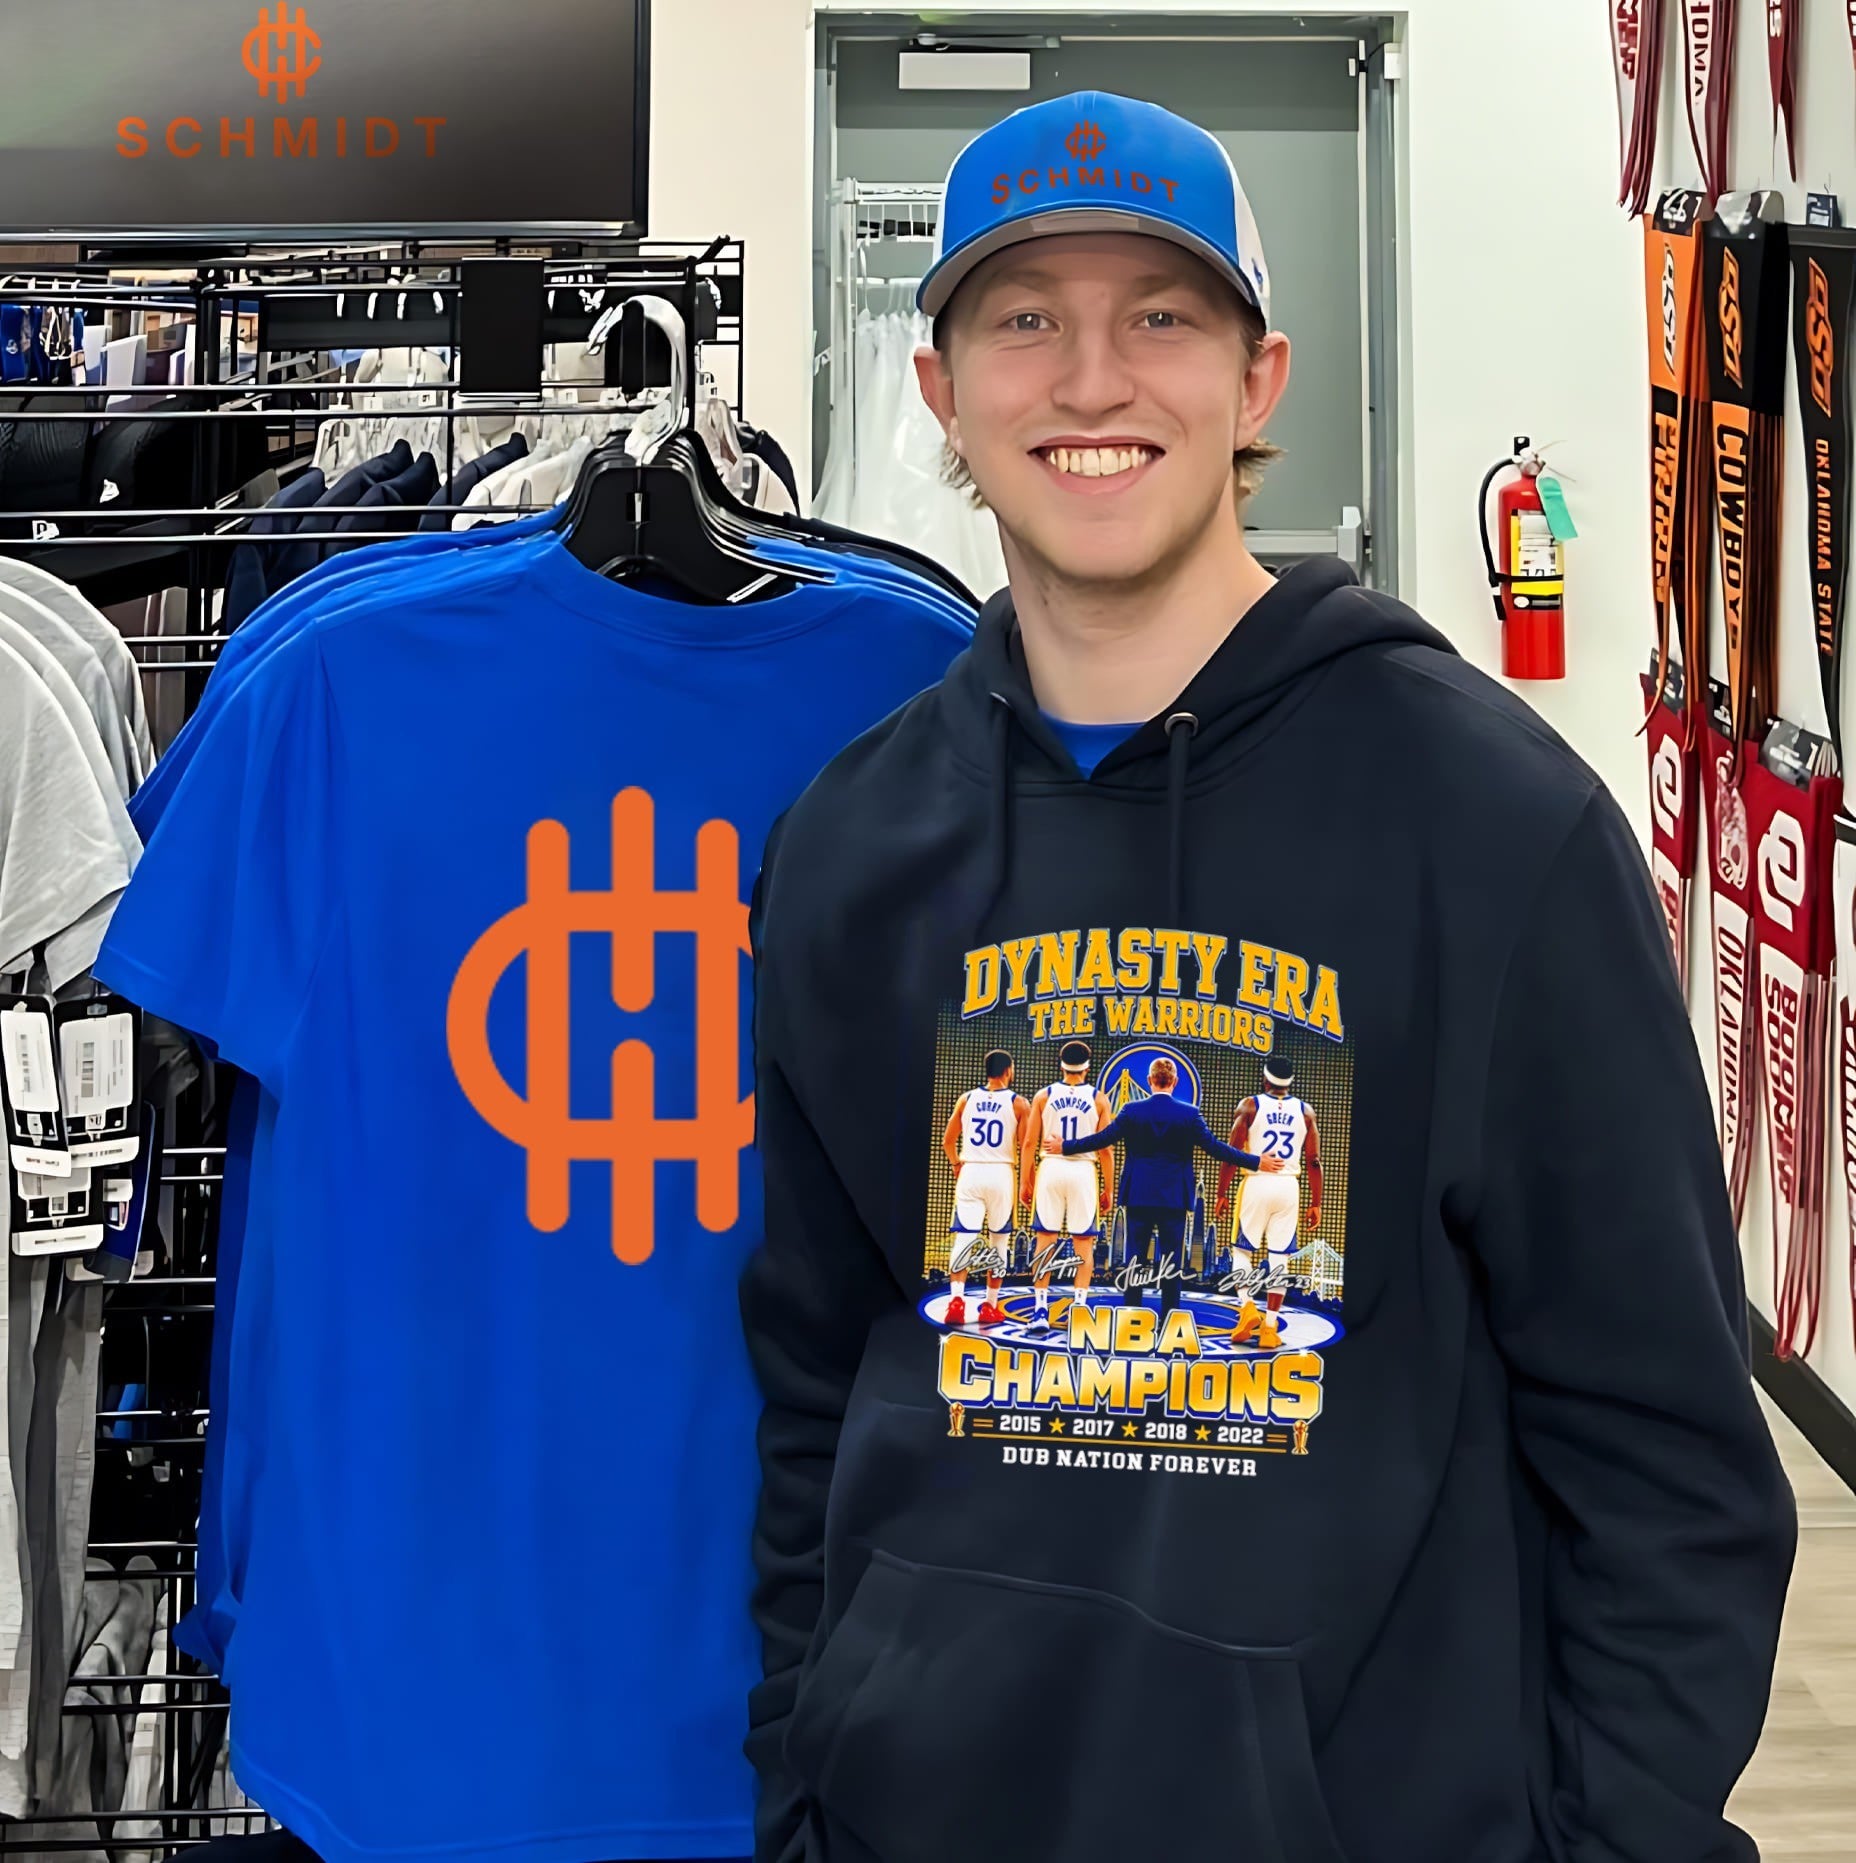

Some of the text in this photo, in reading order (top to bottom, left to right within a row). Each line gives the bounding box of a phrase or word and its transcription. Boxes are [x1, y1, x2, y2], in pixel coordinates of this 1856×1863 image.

[115, 116, 448, 158] SCHMIDT
[991, 167, 1179, 205] SCHMIDT
[1815, 438, 1832, 570] OKLAHOMA
[961, 927, 1344, 1043] DYNASTY ERA
[1028, 996, 1274, 1056] THE WARRIORS
[1050, 1097, 1093, 1115] THOMPSON
[970, 1117, 1004, 1148] 30
[1060, 1115, 1077, 1142] 11
[1262, 1130, 1295, 1159] 23
[1068, 1305, 1203, 1358] NBA
[938, 1333, 1323, 1425] CHAMPIONS
[999, 1414, 1264, 1444] 2015 2017 2018 2022
[1002, 1446, 1257, 1477] DUB NATION FOREVER
